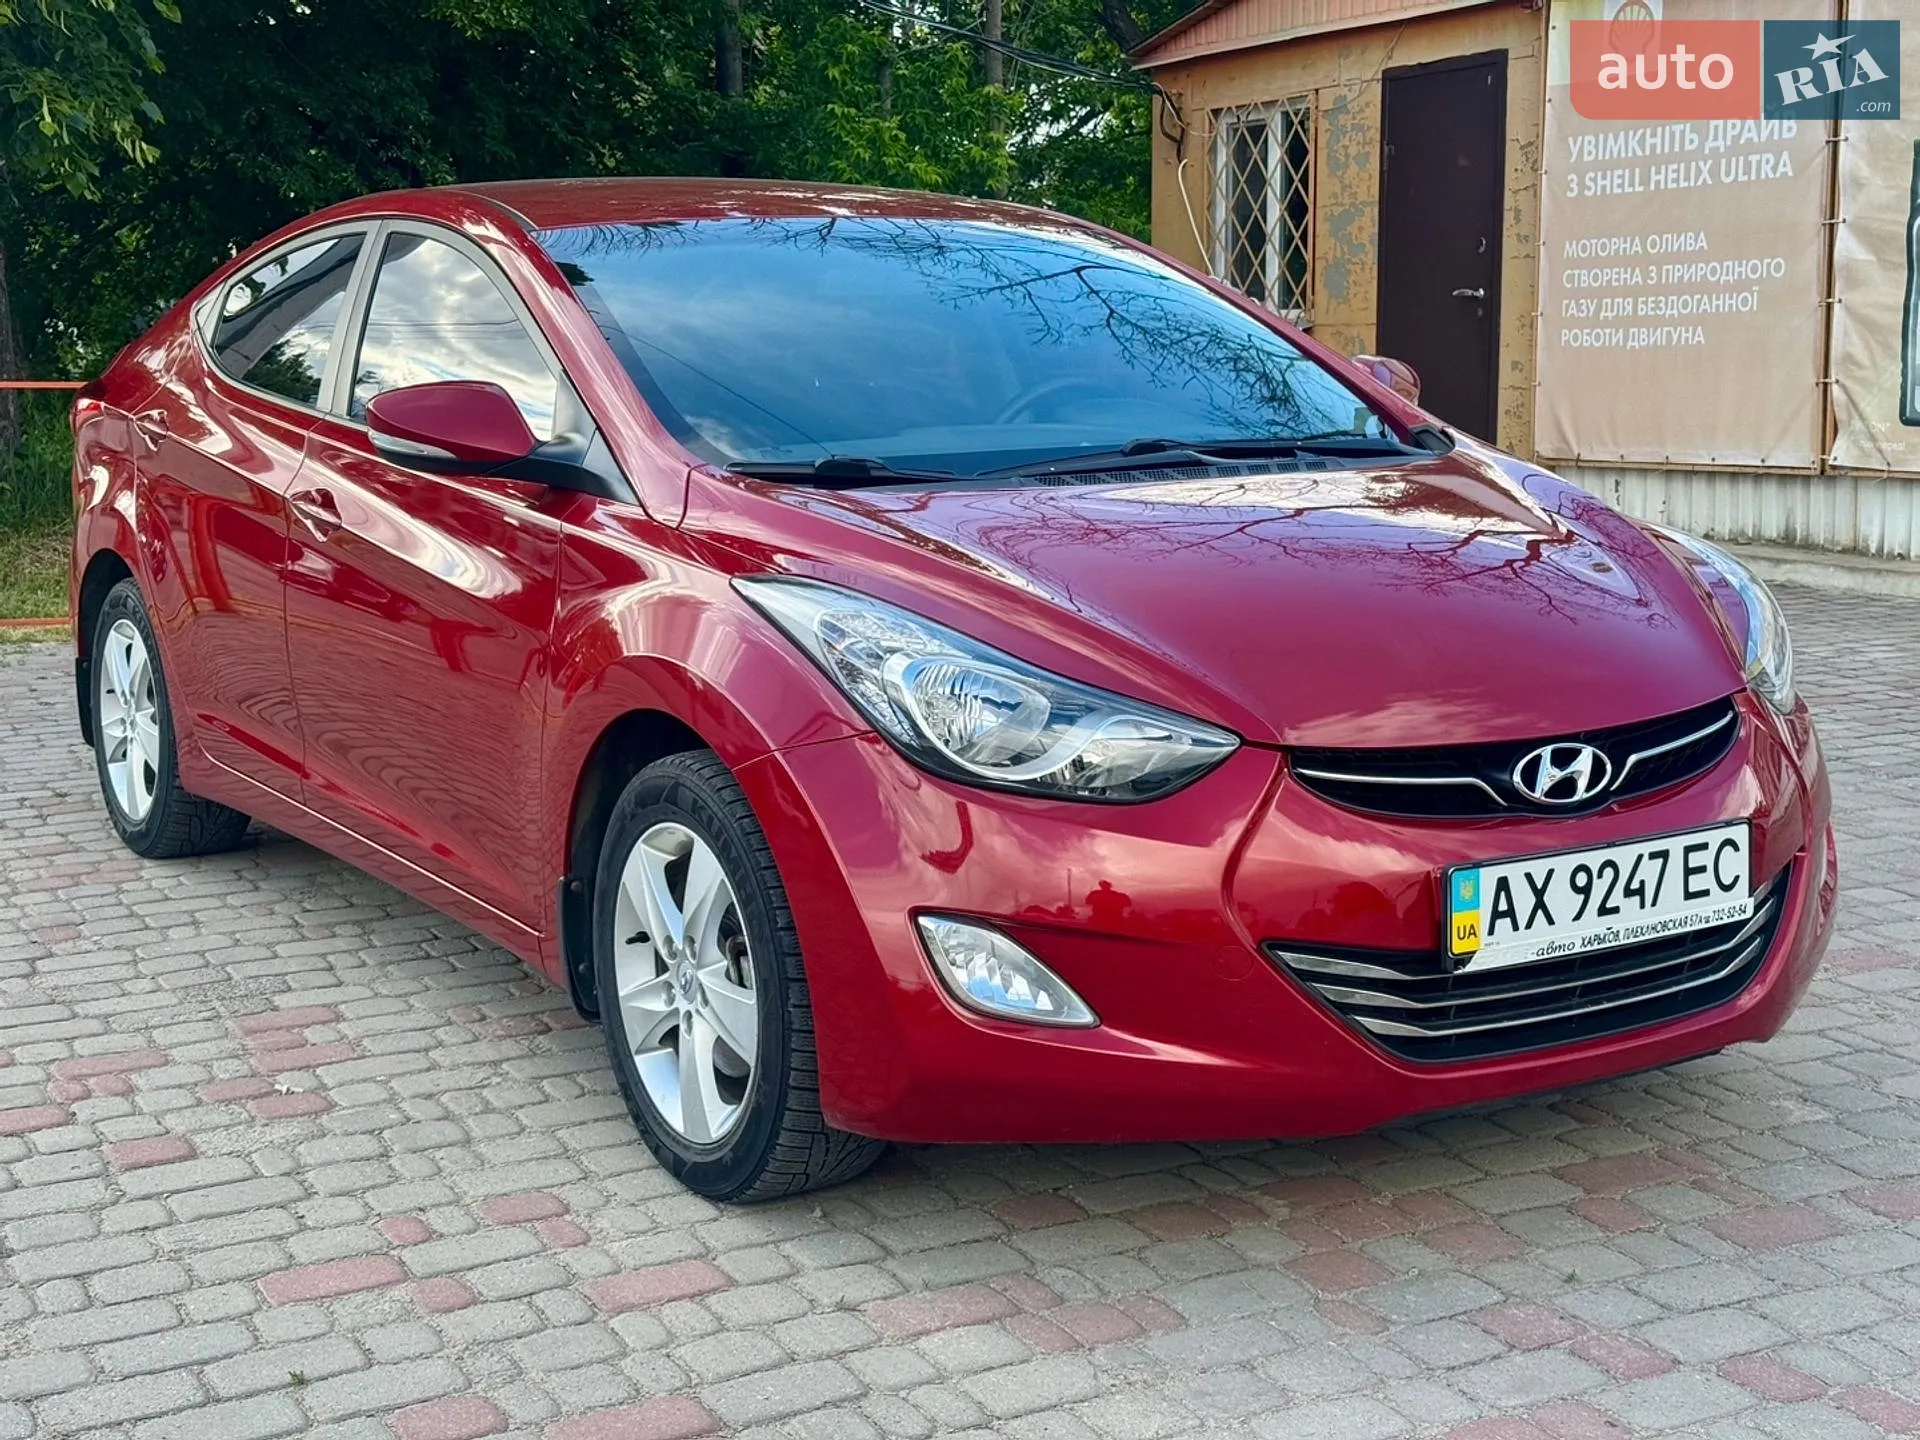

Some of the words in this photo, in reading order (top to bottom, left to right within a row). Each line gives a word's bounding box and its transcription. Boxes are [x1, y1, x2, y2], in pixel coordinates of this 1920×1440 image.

[1567, 123, 1699, 163] УВІМКНІТЬ
[1584, 167, 1645, 197] SHELL
[1650, 159, 1713, 191] HELIX
[1720, 150, 1794, 184] ULTRA
[1563, 236, 1642, 259] МОТОРНА
[1646, 231, 1708, 254] ОЛИВА
[1562, 267, 1643, 289] СТВОРЕНА
[1662, 257, 1786, 285] ПРИРОДНОГО
[1562, 298, 1597, 318] ГАЗУ
[1600, 297, 1632, 320] ДЛЯ
[1637, 286, 1760, 319] БЕЗДОГАННОЇ
[1561, 327, 1623, 347] РОБОТИ
[1626, 325, 1706, 350] ДВИГУНА
[1487, 867, 1556, 937] AX
[1569, 848, 1670, 922] 9247
[1683, 837, 1741, 901] EC
[1456, 923, 1478, 941] UA
